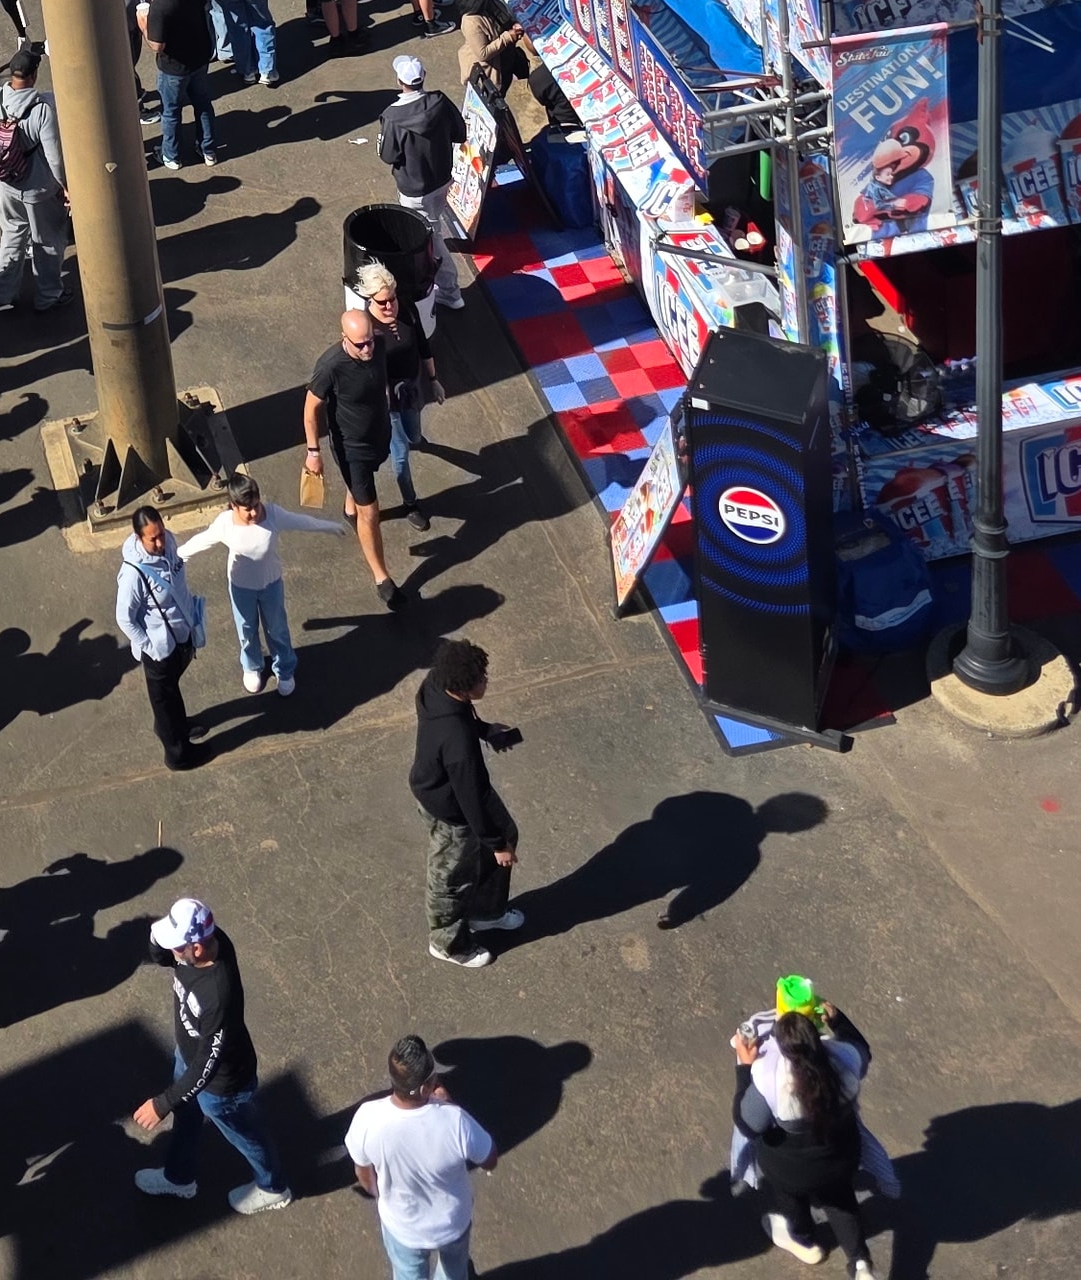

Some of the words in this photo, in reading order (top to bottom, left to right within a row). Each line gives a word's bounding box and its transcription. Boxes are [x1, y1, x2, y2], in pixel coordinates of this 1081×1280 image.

[835, 48, 868, 69] State
[866, 44, 894, 62] Fair
[835, 44, 919, 113] DESTINATION
[639, 40, 705, 179] HERE
[849, 54, 944, 134] FUN!
[803, 173, 824, 198] ICEE
[1011, 159, 1060, 202] ICEE
[655, 272, 702, 368] ICEE
[1036, 442, 1081, 503] IC
[724, 503, 780, 527] PEPSI
[181, 1028, 225, 1103] TAKEDOWN
